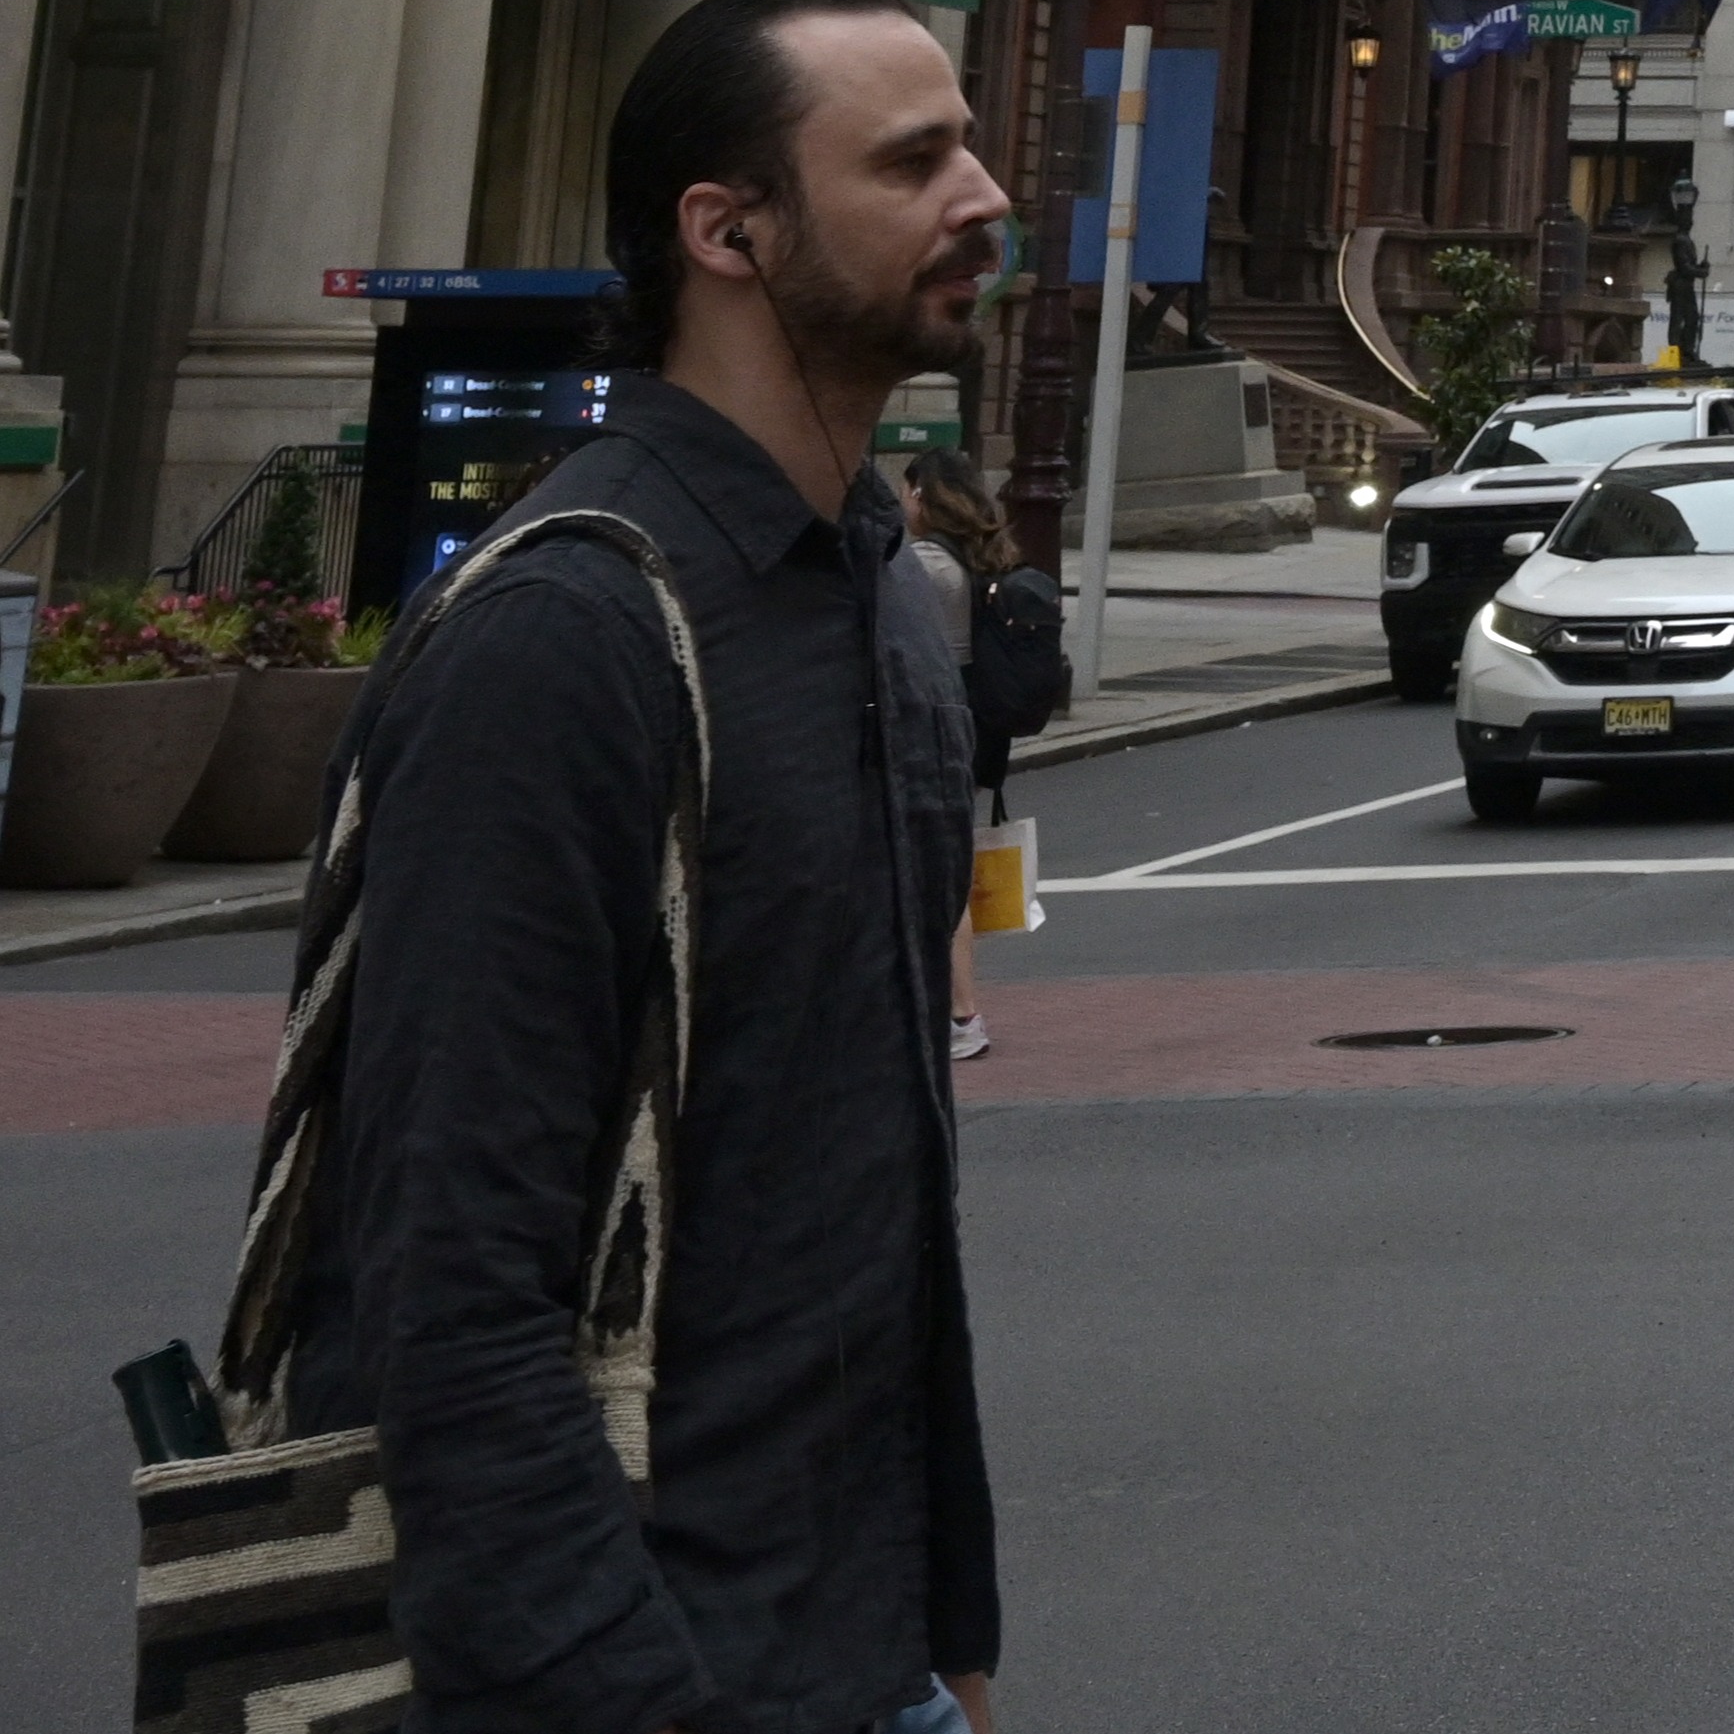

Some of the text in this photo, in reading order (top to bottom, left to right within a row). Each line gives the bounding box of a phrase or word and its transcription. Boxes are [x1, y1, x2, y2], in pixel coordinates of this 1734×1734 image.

[1613, 19, 1630, 34] ST
[430, 482, 456, 500] THE
[459, 482, 500, 500] MOST
